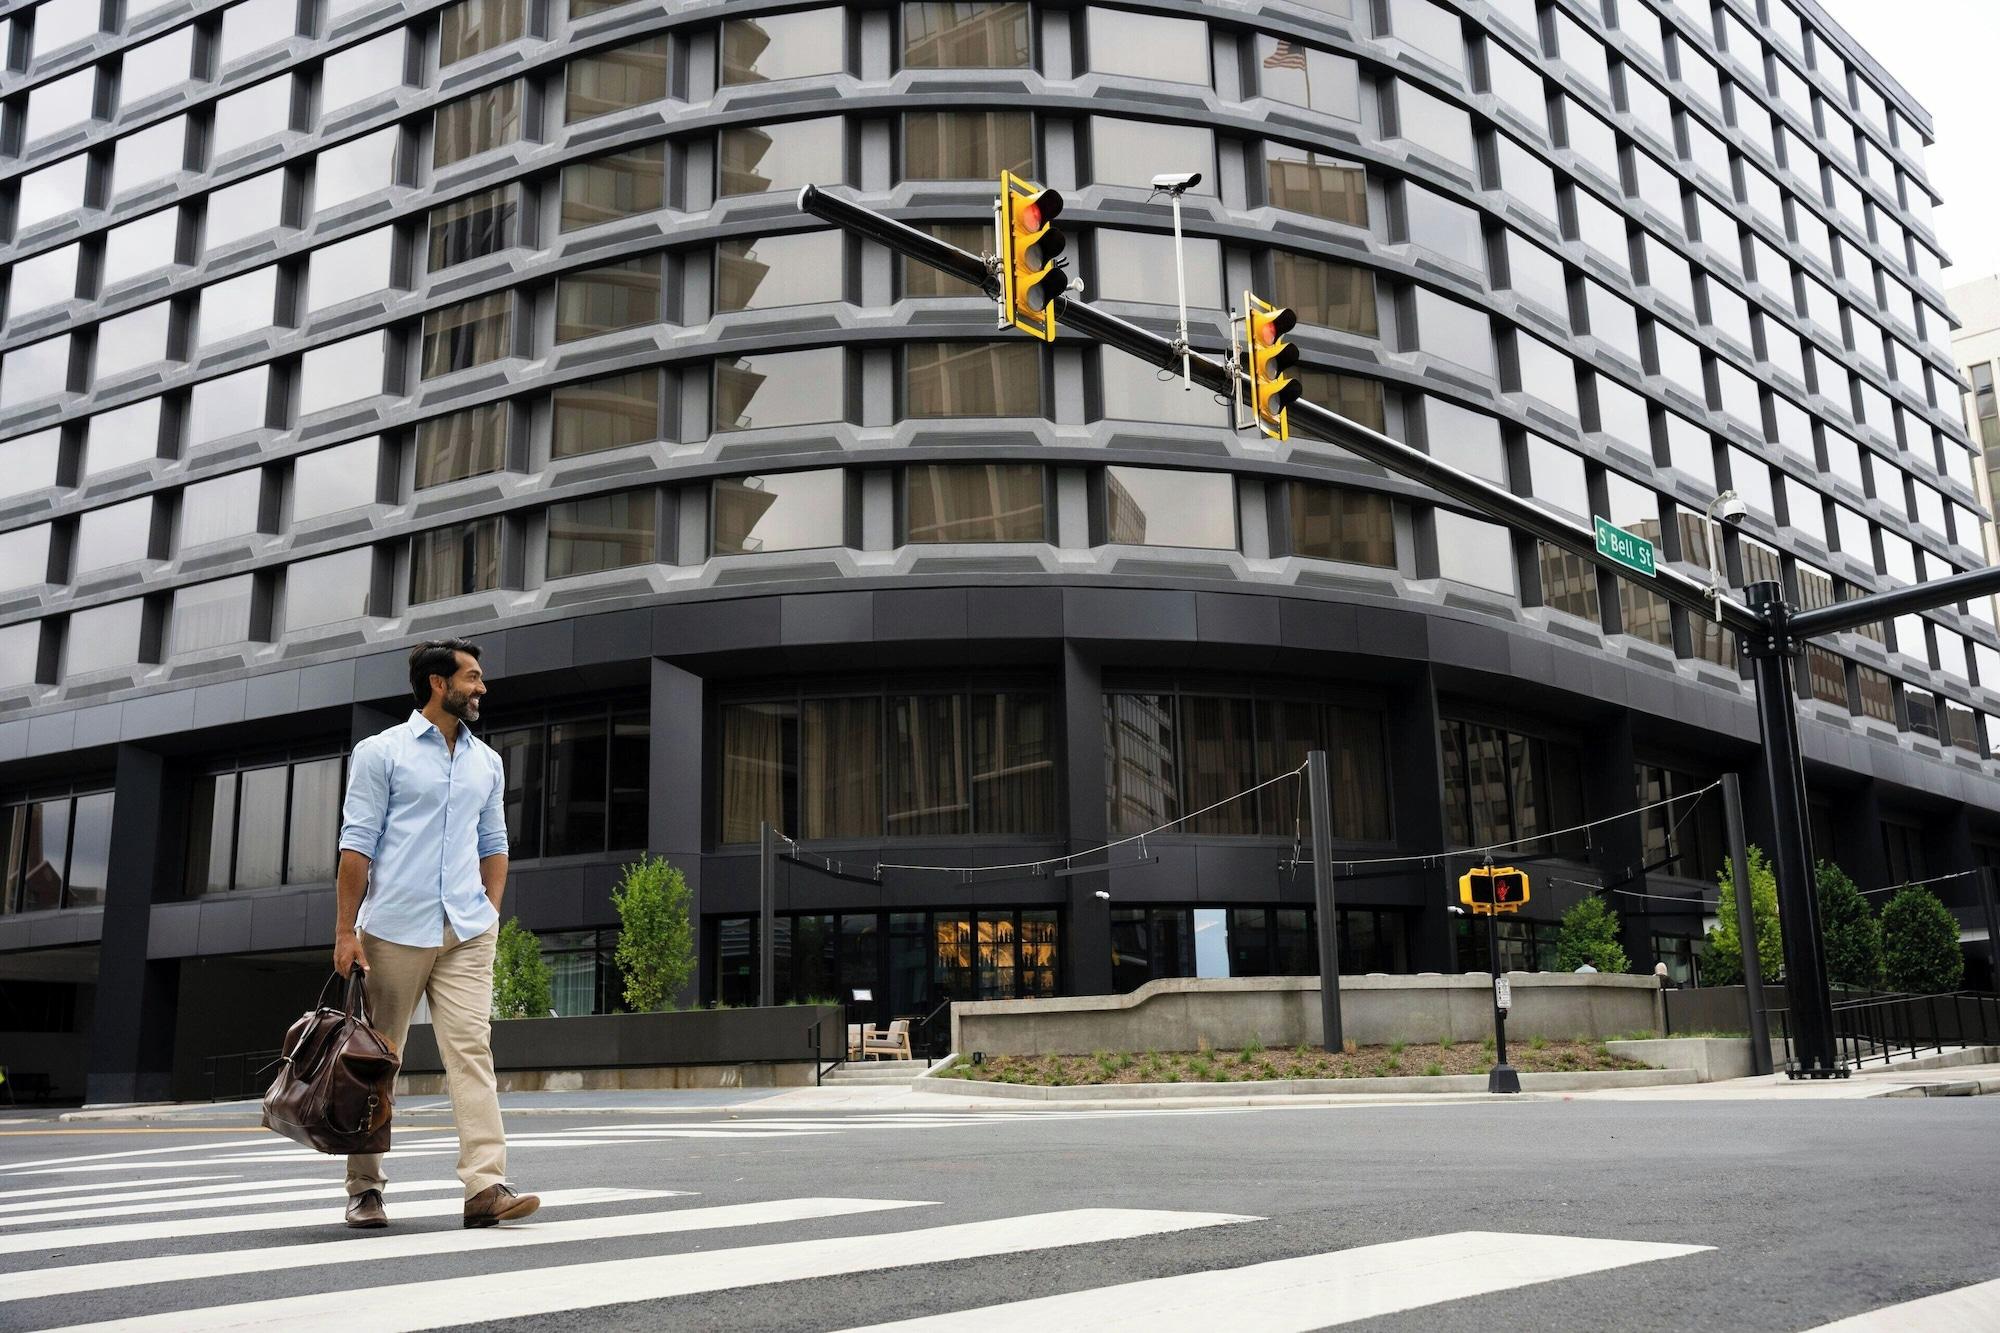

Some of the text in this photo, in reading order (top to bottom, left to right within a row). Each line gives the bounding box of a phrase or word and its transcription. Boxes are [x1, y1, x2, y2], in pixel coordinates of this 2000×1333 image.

[1599, 527, 1652, 567] S Bell St
